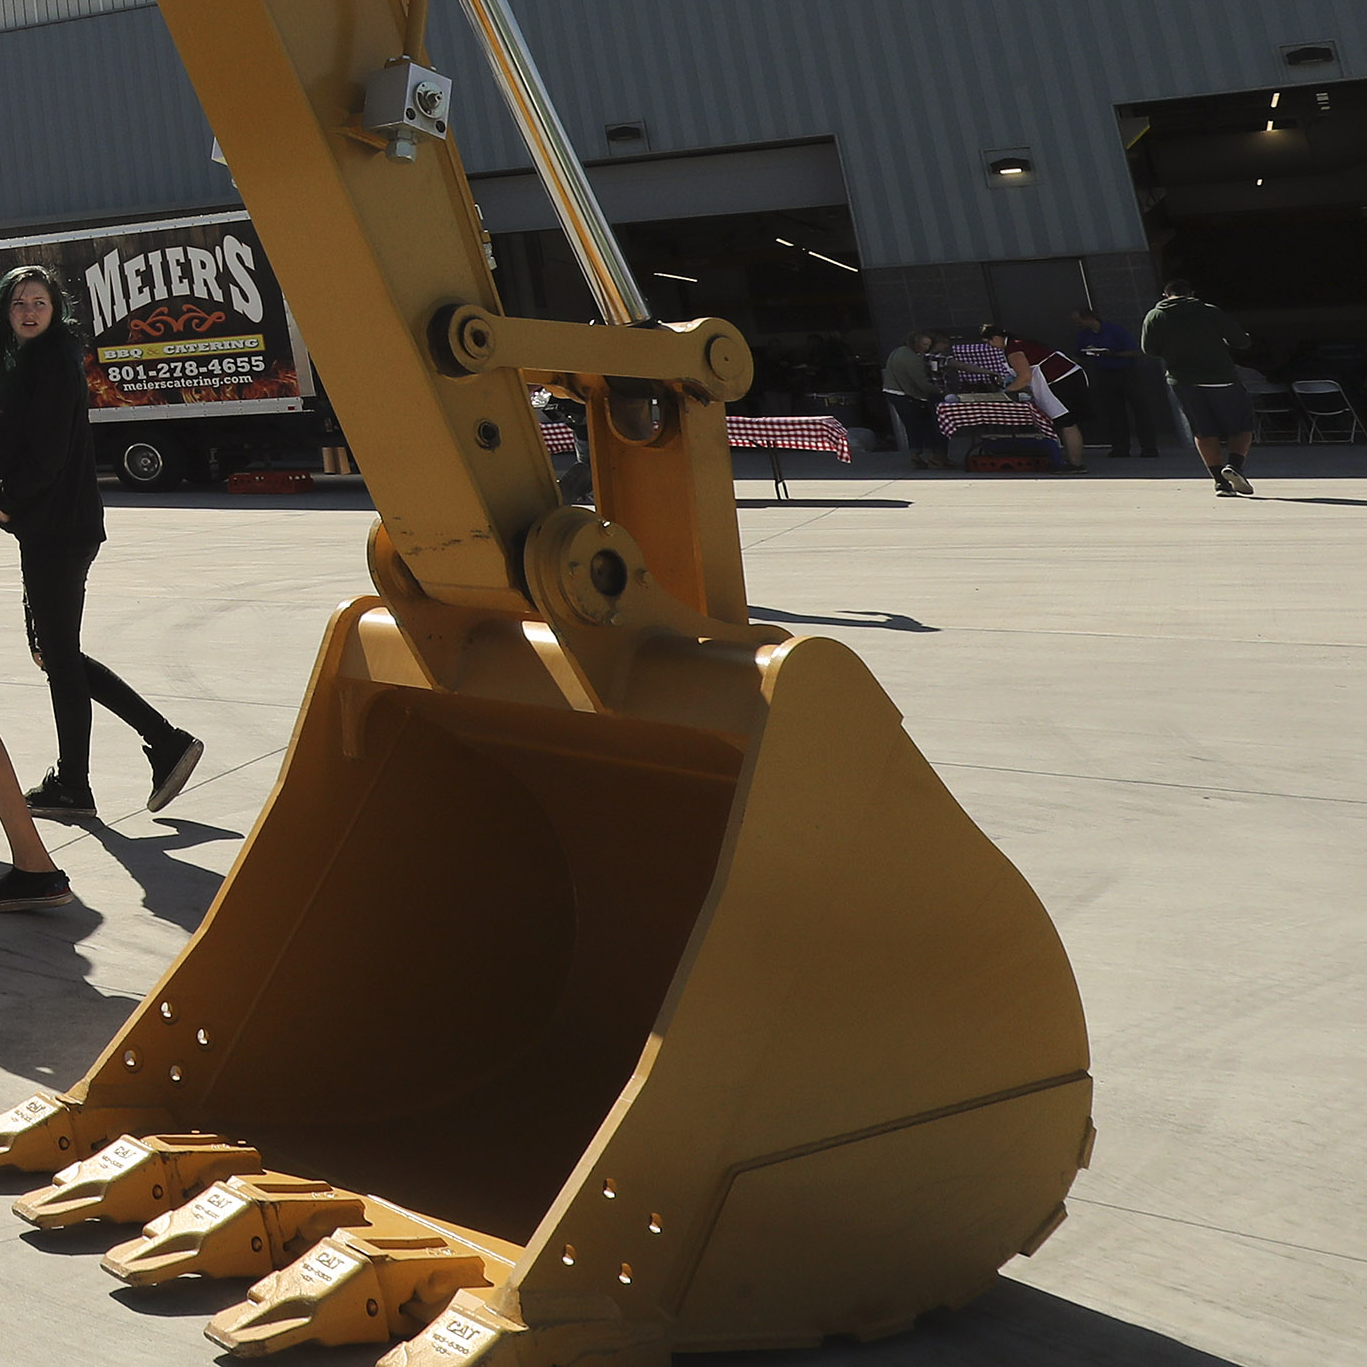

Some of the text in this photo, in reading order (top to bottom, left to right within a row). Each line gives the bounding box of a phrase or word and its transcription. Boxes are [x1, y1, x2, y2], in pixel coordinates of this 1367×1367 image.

[84, 234, 264, 337] MEIER'S
[103, 338, 259, 359] BBQ & CATERING
[107, 356, 266, 382] 801-278-4655
[123, 373, 254, 392] meierscatering.com
[315, 1251, 345, 1270] CAT
[446, 1320, 481, 1341] CAT
